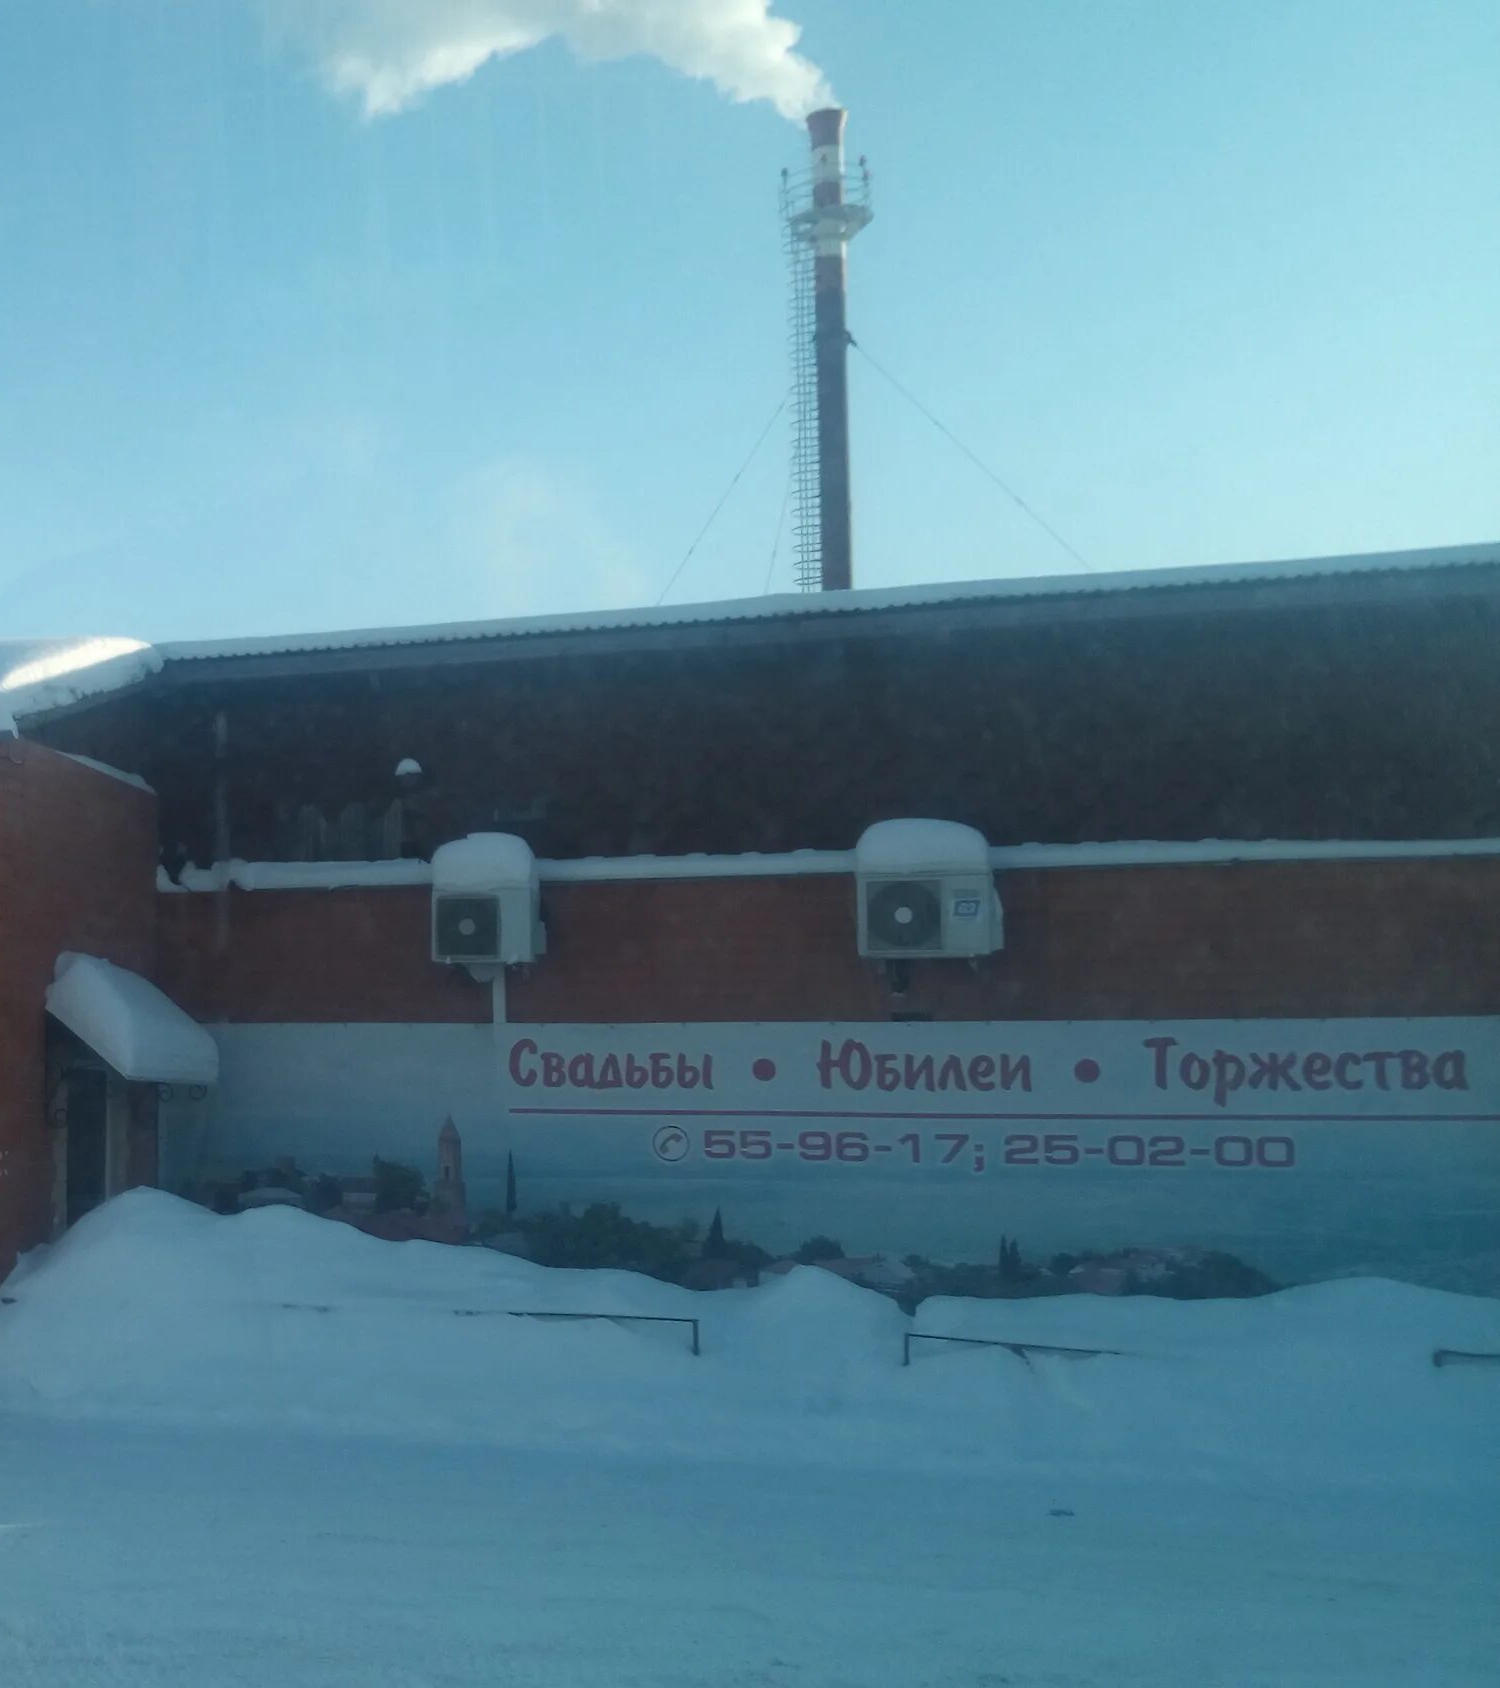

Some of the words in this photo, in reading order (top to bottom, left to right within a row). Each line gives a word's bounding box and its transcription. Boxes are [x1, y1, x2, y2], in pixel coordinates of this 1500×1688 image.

[508, 1038, 715, 1091] Свадьбы
[816, 1037, 1033, 1093] Юбилеи
[1141, 1035, 1471, 1108] Торжества
[703, 1129, 986, 1174] 55-96-17;
[1003, 1133, 1296, 1168] 25-02-00
